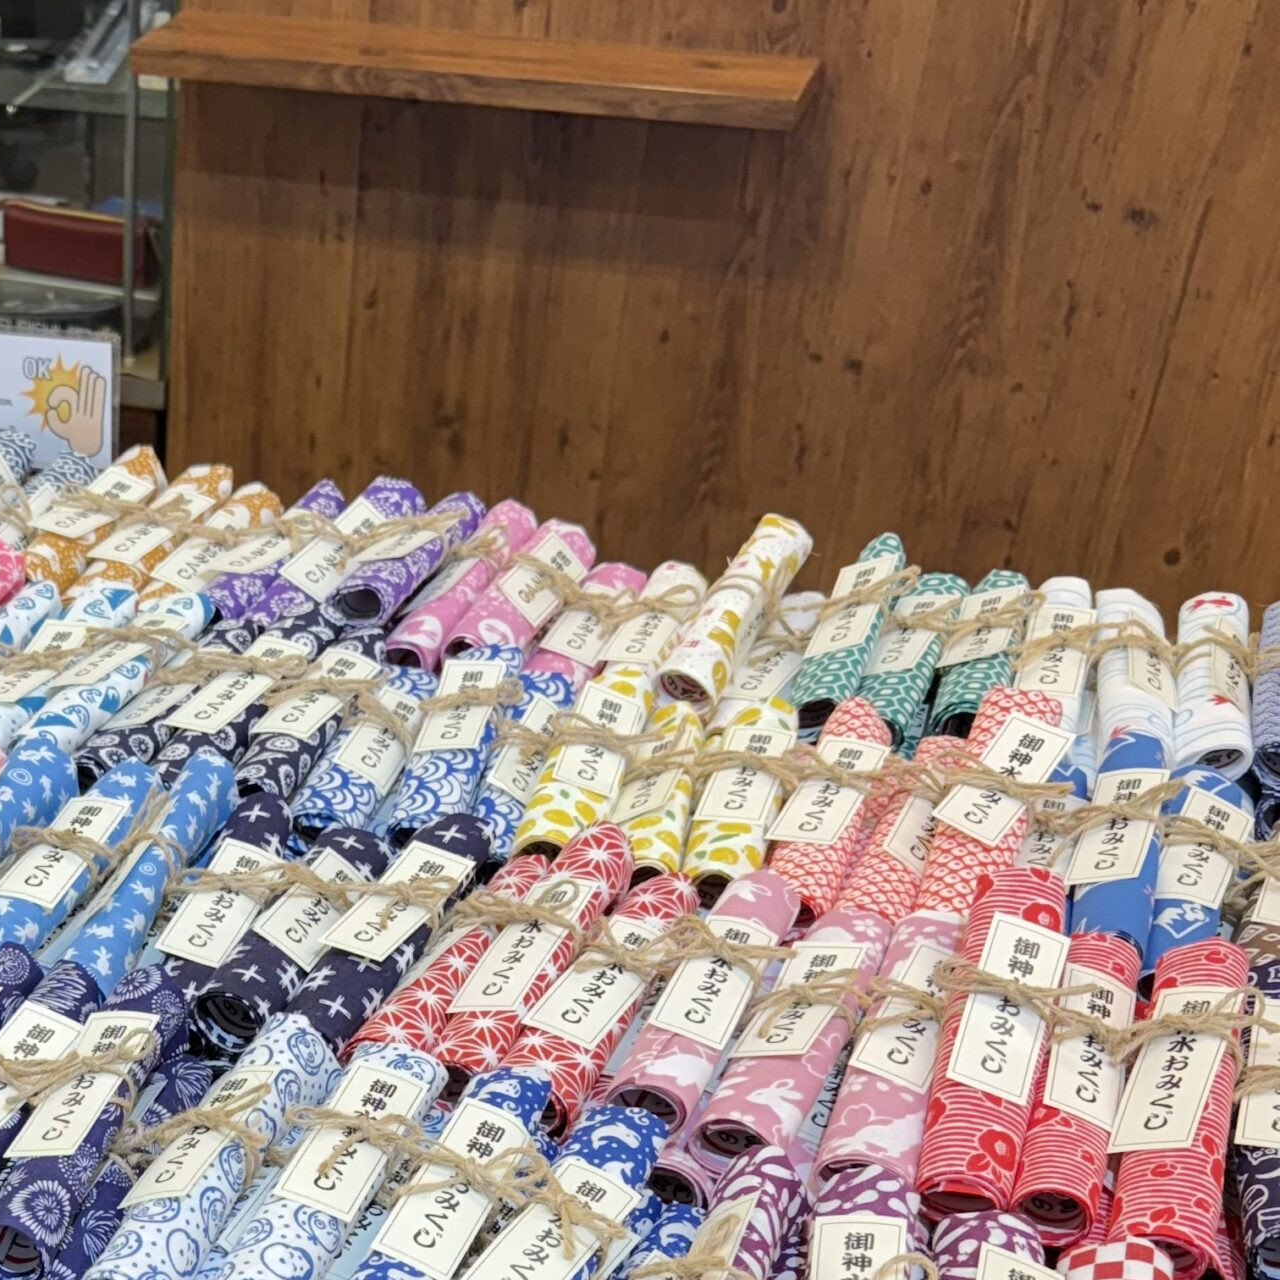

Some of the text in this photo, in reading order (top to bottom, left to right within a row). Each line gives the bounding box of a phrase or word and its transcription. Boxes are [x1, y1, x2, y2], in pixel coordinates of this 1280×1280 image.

[23, 356, 52, 380] OK
[981, 938, 1040, 1074] 御神おみくじ
[1075, 987, 1114, 1103] 御神おみくじ
[42, 1024, 128, 1141] 御神おみくじ
